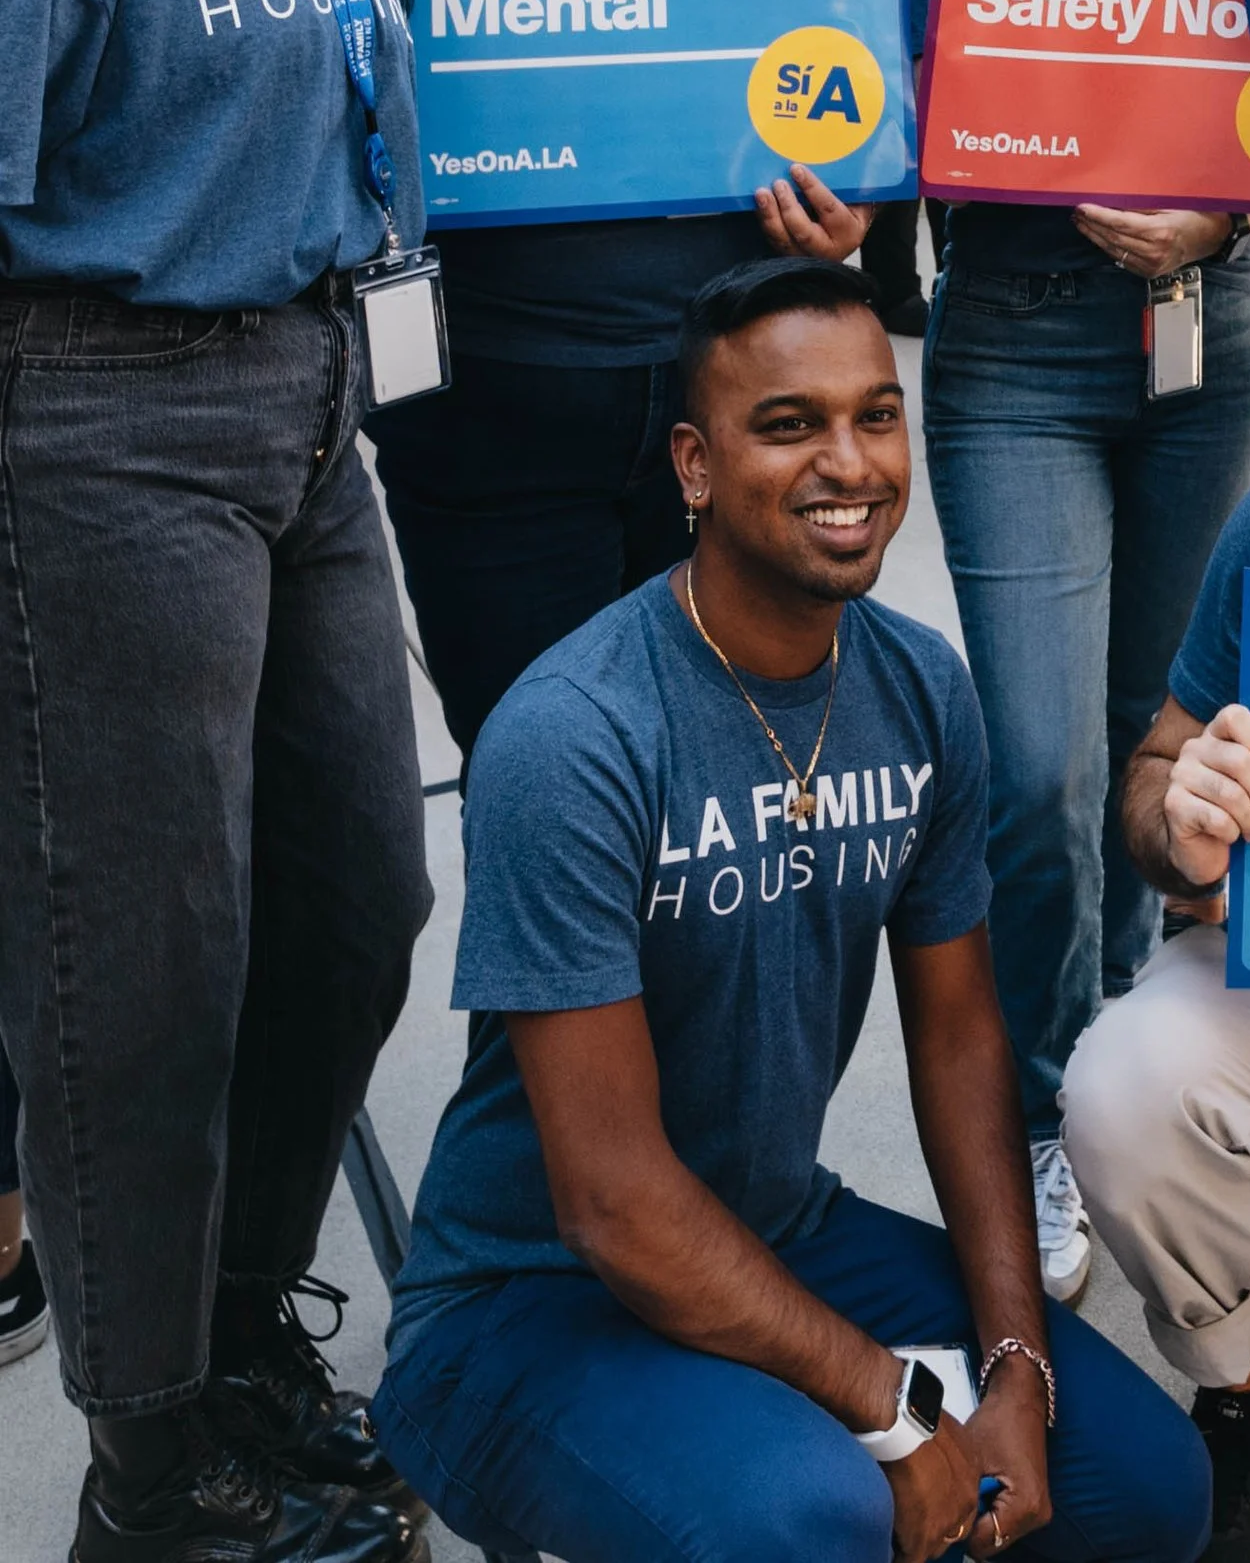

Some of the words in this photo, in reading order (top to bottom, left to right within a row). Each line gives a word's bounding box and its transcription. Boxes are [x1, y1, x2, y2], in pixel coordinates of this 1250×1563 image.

[354, 19, 364, 58] FAMILY
[777, 64, 815, 96] Sí
[807, 66, 861, 124] A
[785, 99, 799, 113] la
[951, 129, 1080, 157] YesOnA.LA
[429, 146, 578, 176] YesOnA.LA
[658, 796, 737, 865] LA
